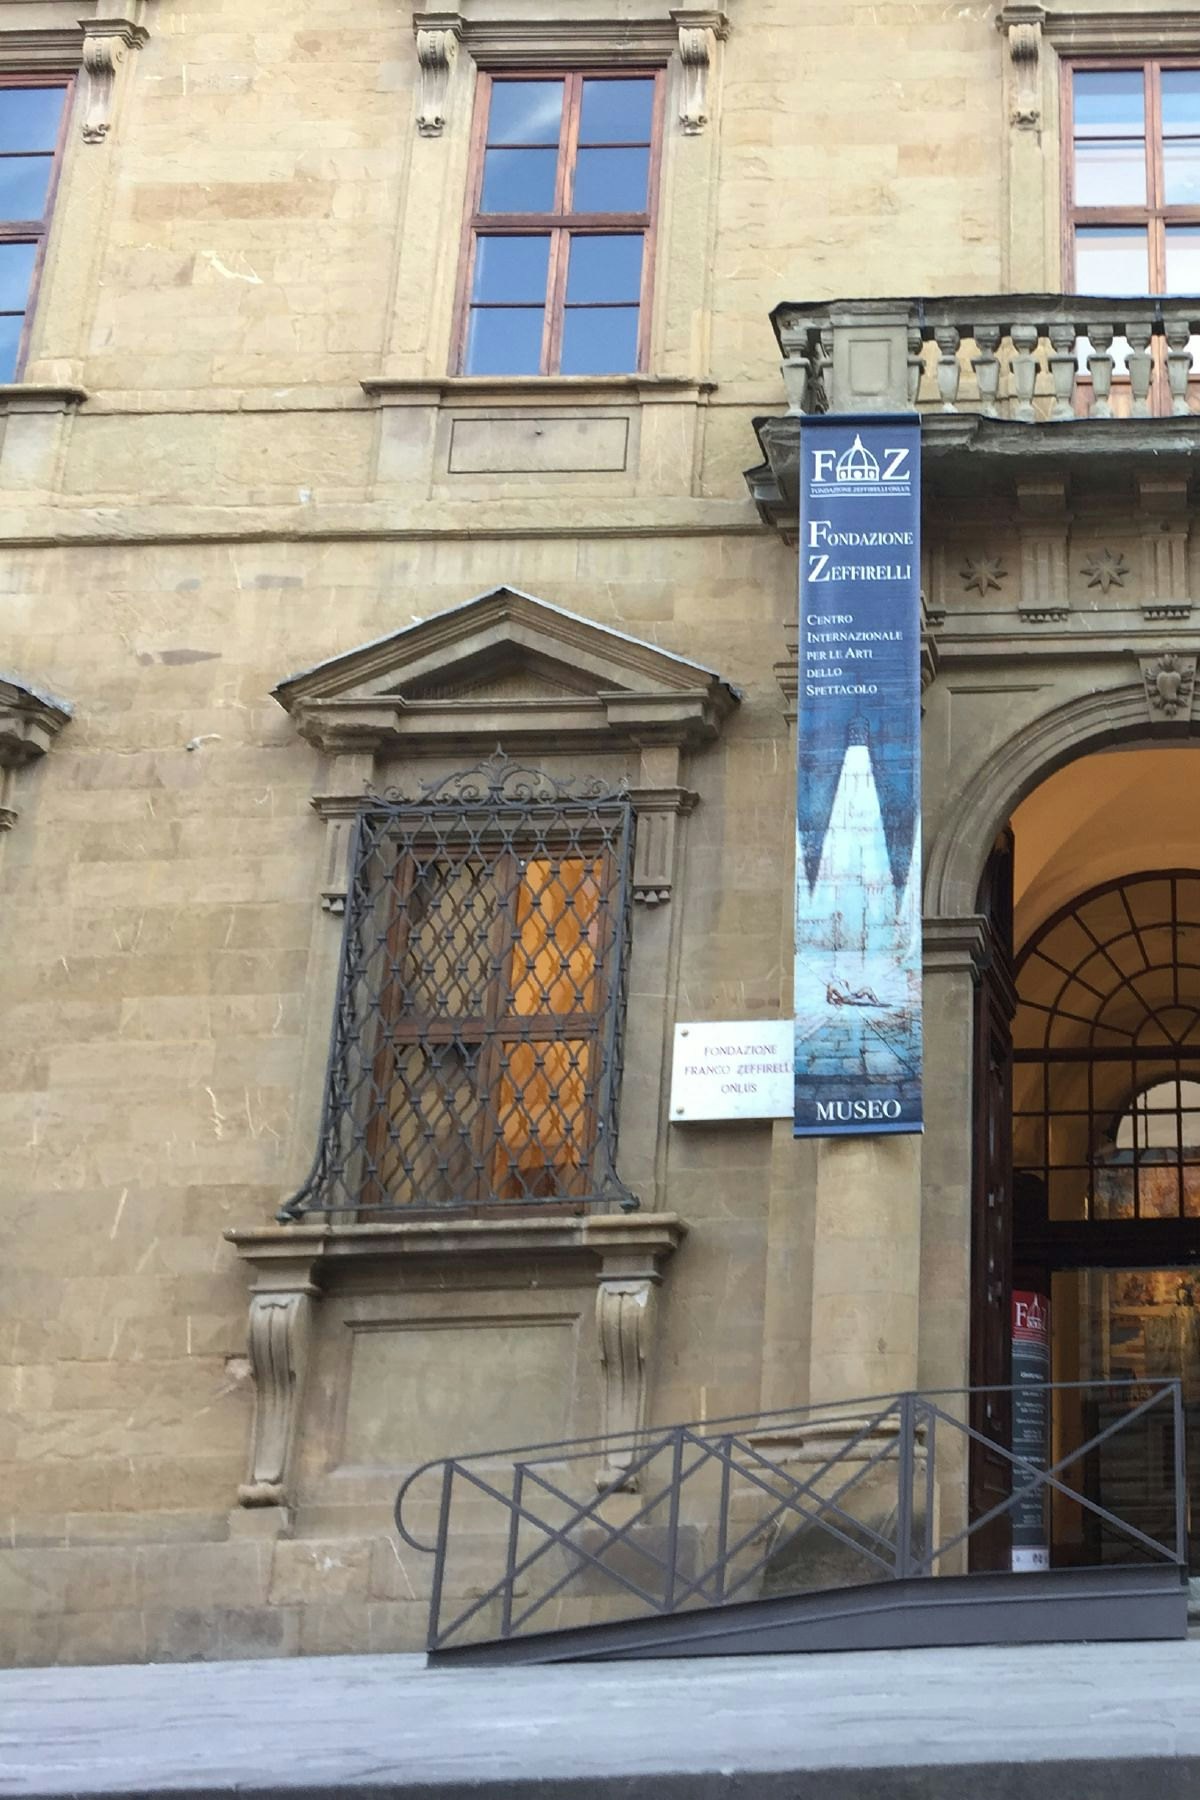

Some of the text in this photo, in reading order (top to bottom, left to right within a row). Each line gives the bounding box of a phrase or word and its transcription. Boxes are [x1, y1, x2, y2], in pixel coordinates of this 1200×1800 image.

[808, 520, 914, 548] FONDAZIONE
[808, 554, 912, 583] ZEFFIRELLI
[807, 614, 854, 626] CENTRO
[807, 631, 903, 644] INTERNAZIONALE
[845, 647, 873, 659] ARTI
[807, 667, 842, 678] DELLO
[806, 684, 878, 697] SPETTACOLO
[704, 1045, 777, 1057] FONDAZIONE
[684, 1065, 731, 1076] FRANCO
[721, 1082, 758, 1094] ONLUS
[816, 1099, 902, 1121] MUSEO
